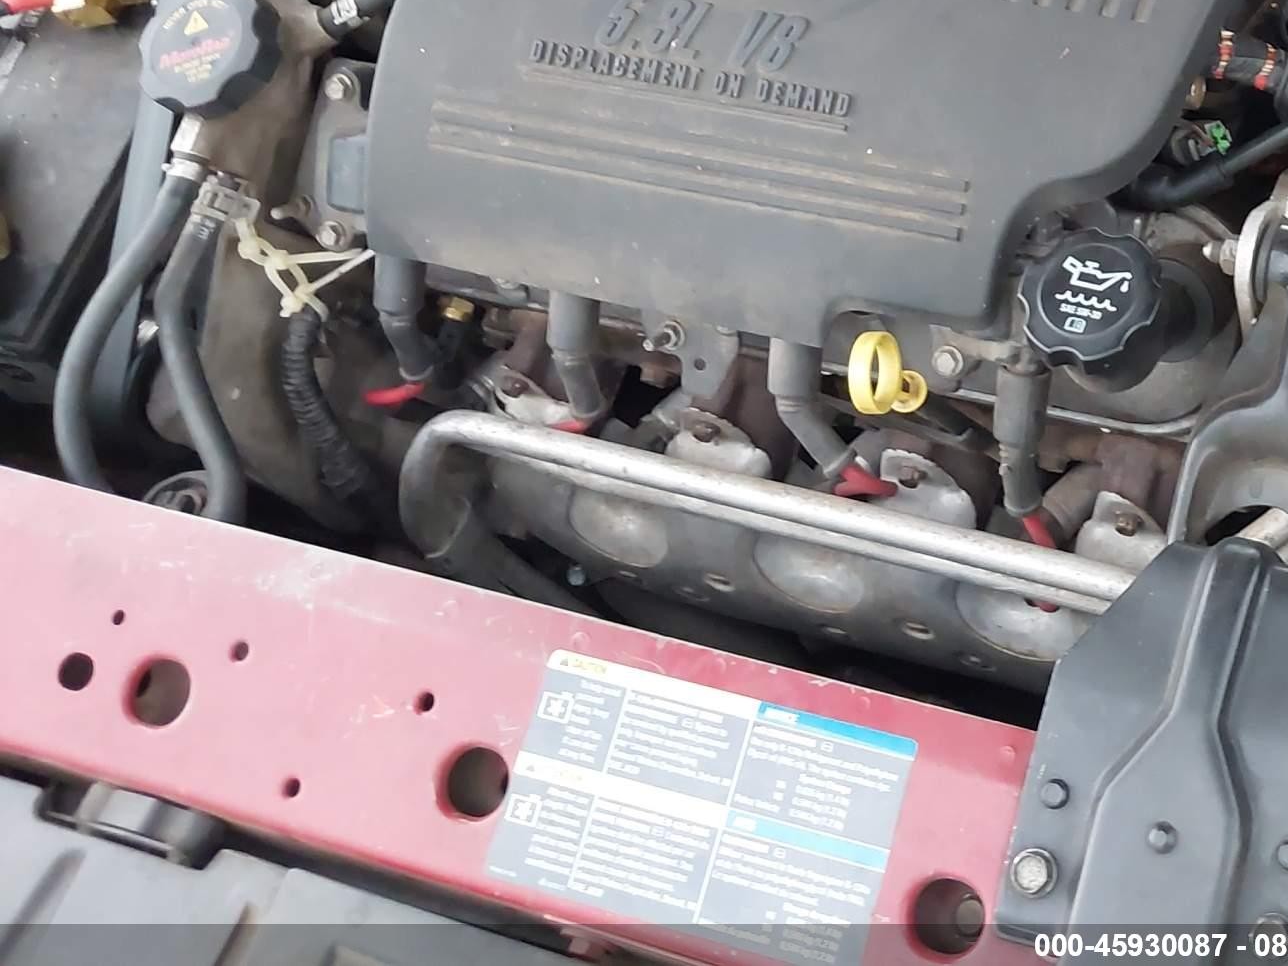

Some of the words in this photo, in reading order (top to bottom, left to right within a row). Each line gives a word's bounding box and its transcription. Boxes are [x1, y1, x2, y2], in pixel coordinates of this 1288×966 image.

[729, 10, 812, 72] V8
[528, 38, 704, 91] DISPLACEMENT
[713, 70, 745, 99] ON
[757, 78, 855, 117] DEMAND
